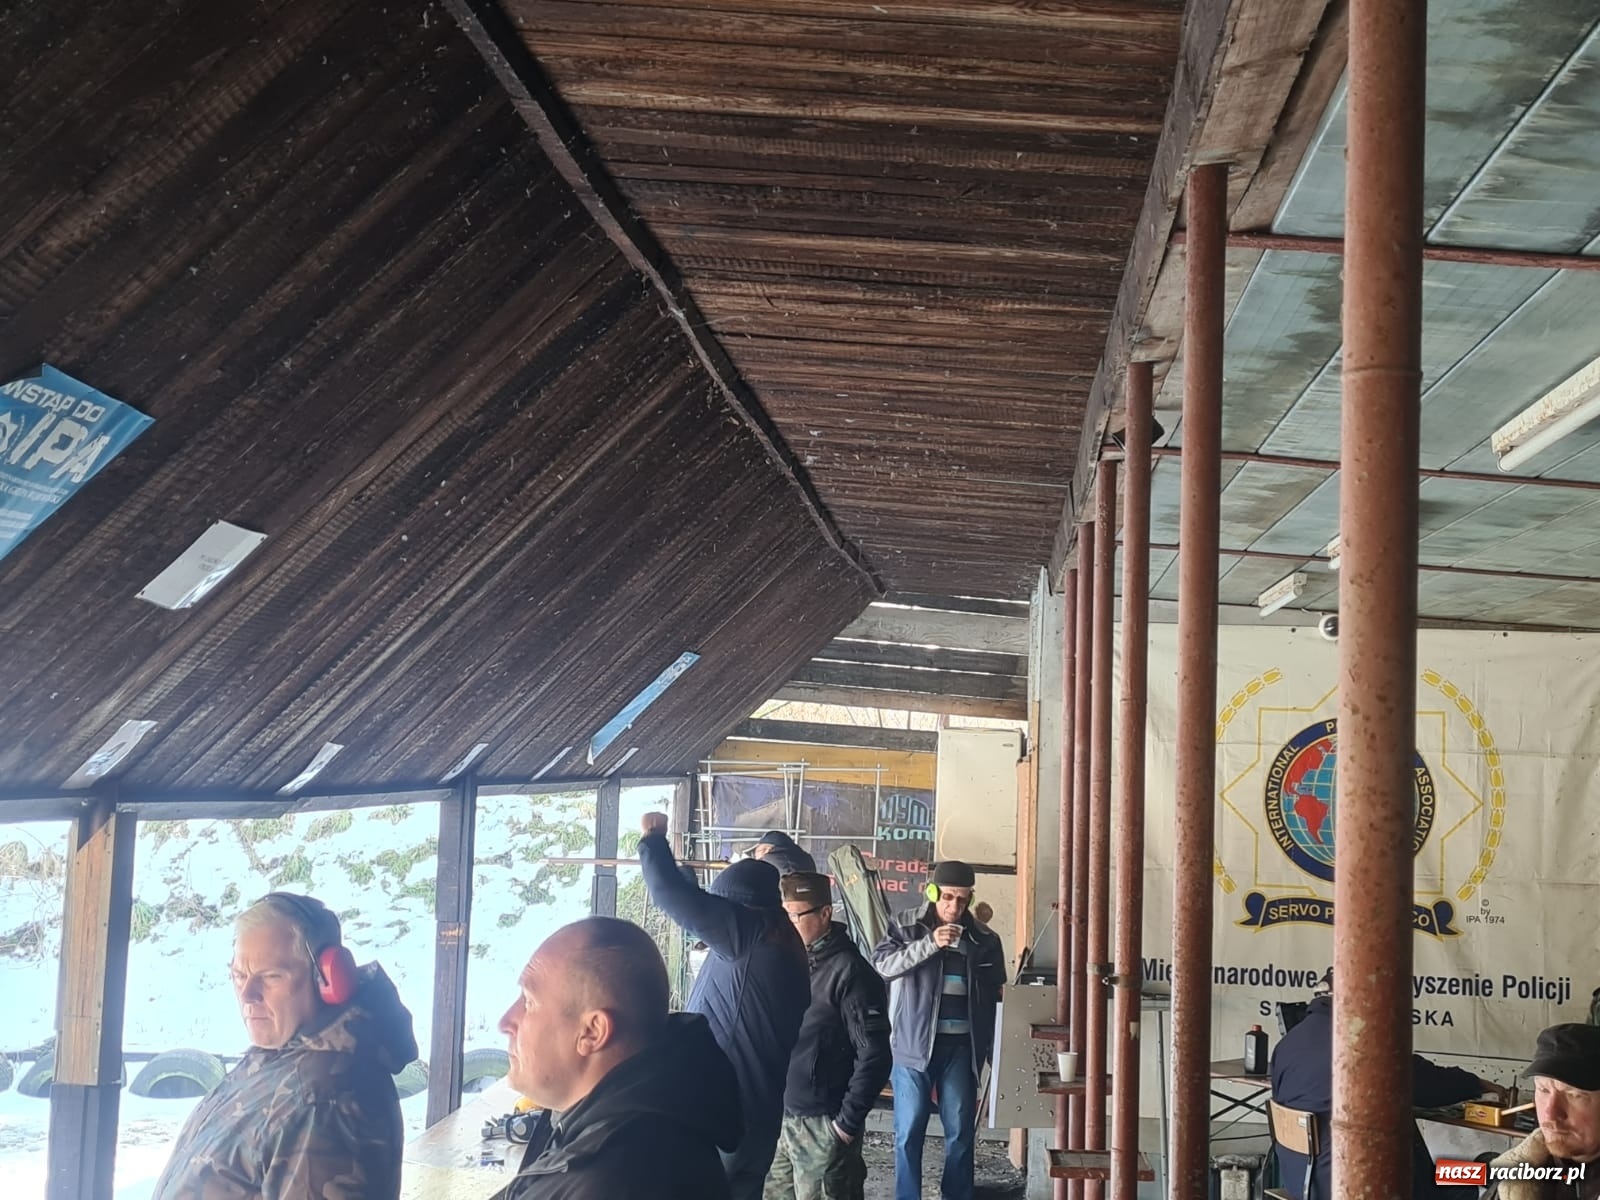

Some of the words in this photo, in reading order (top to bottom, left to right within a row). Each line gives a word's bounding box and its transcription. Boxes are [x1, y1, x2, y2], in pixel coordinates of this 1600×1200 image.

[71, 400, 106, 422] DO
[9, 410, 111, 484] IPA
[1266, 744, 1300, 851] INTERNATIONAL
[1412, 766, 1434, 851] ASSOCIATIO
[1268, 903, 1321, 920] SERVO
[1466, 915, 1481, 924] IPA
[1485, 915, 1505, 925] 1974
[1480, 907, 1491, 919] by
[1502, 974, 1571, 1006] Policji
[1412, 1009, 1455, 1028] SKA
